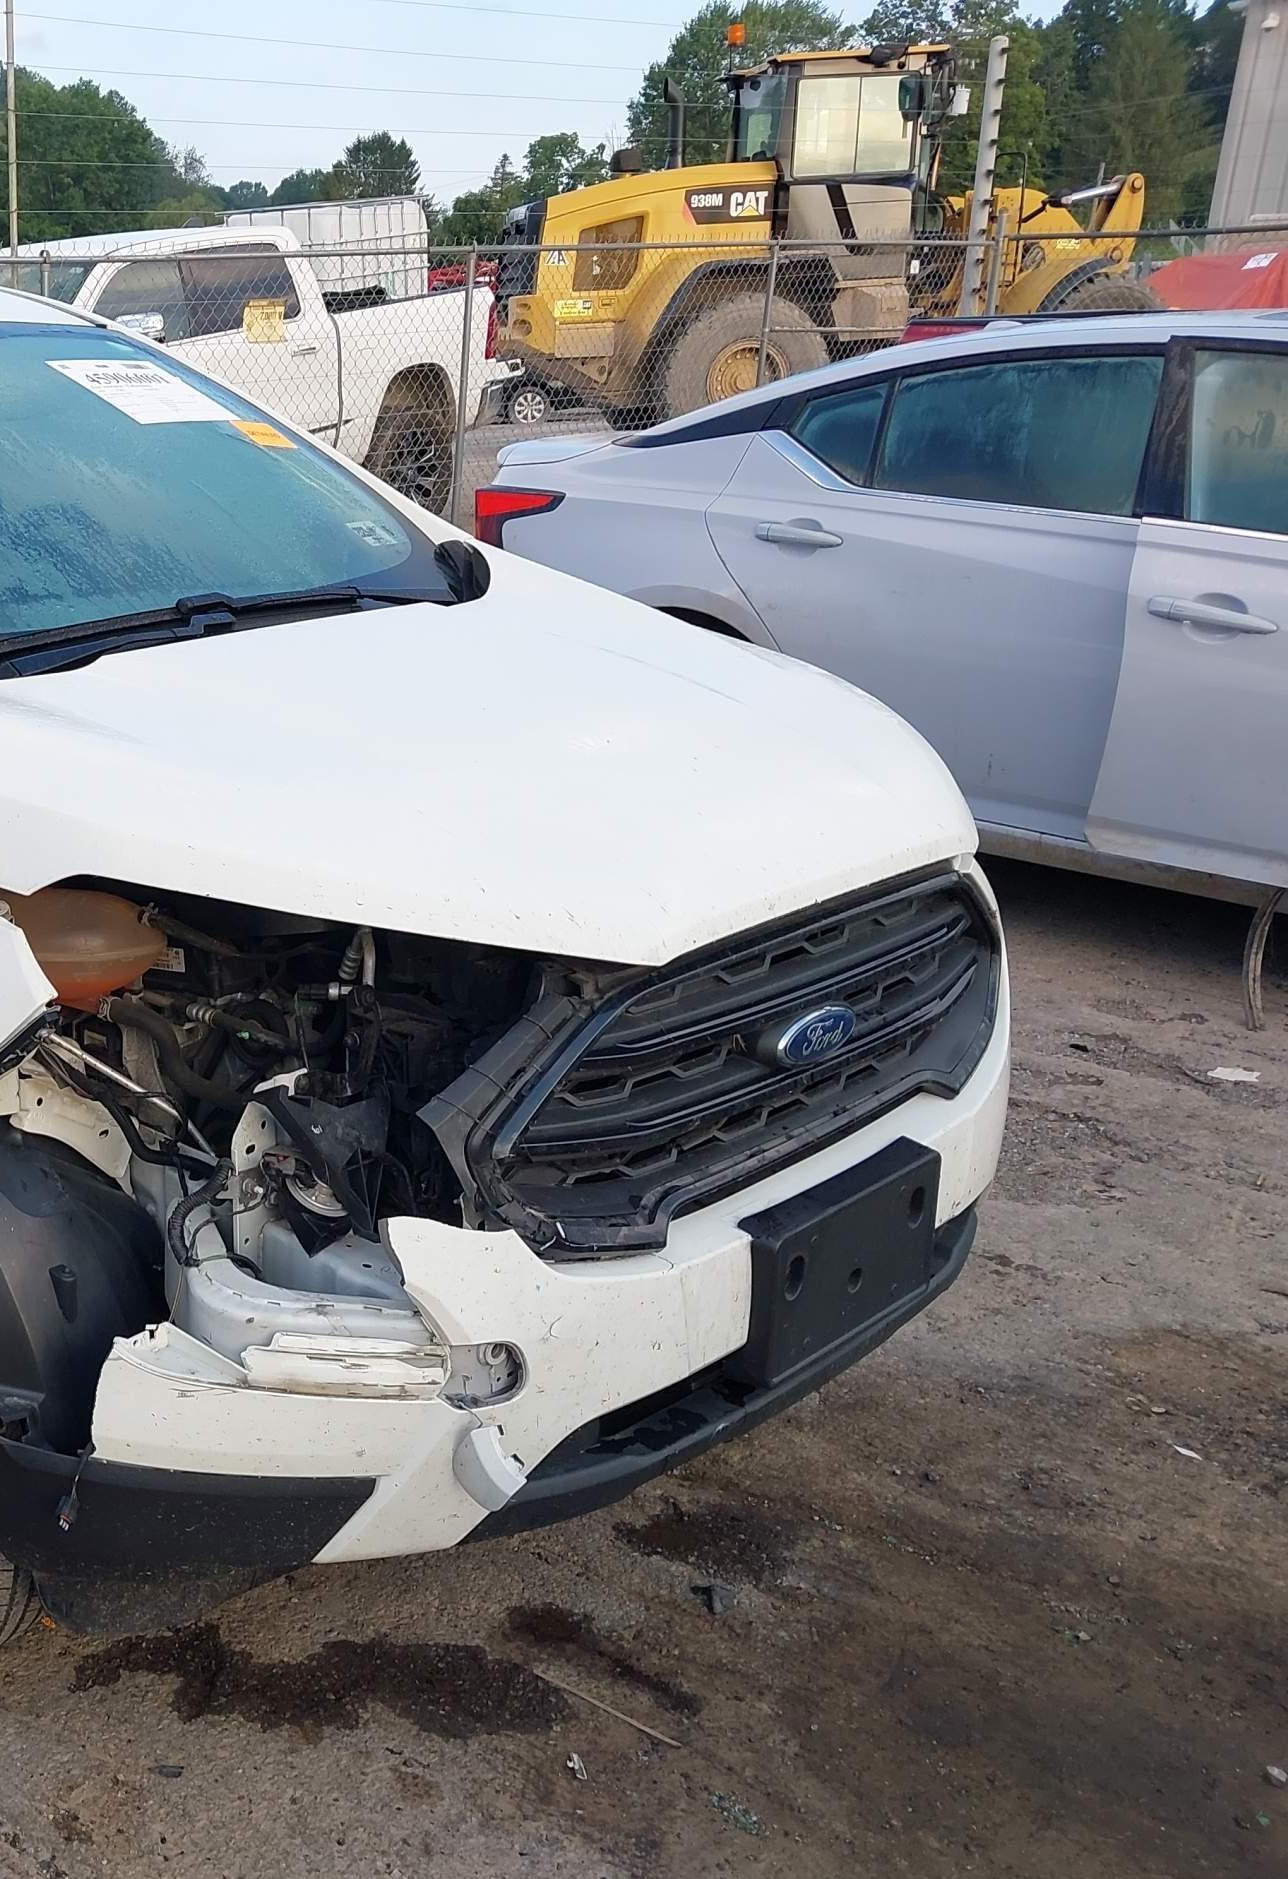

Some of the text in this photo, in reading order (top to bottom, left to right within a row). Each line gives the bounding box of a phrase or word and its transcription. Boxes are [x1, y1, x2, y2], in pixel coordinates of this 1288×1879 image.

[690, 191, 769, 217] 938M CAT
[802, 1018, 845, 1056] Ford
